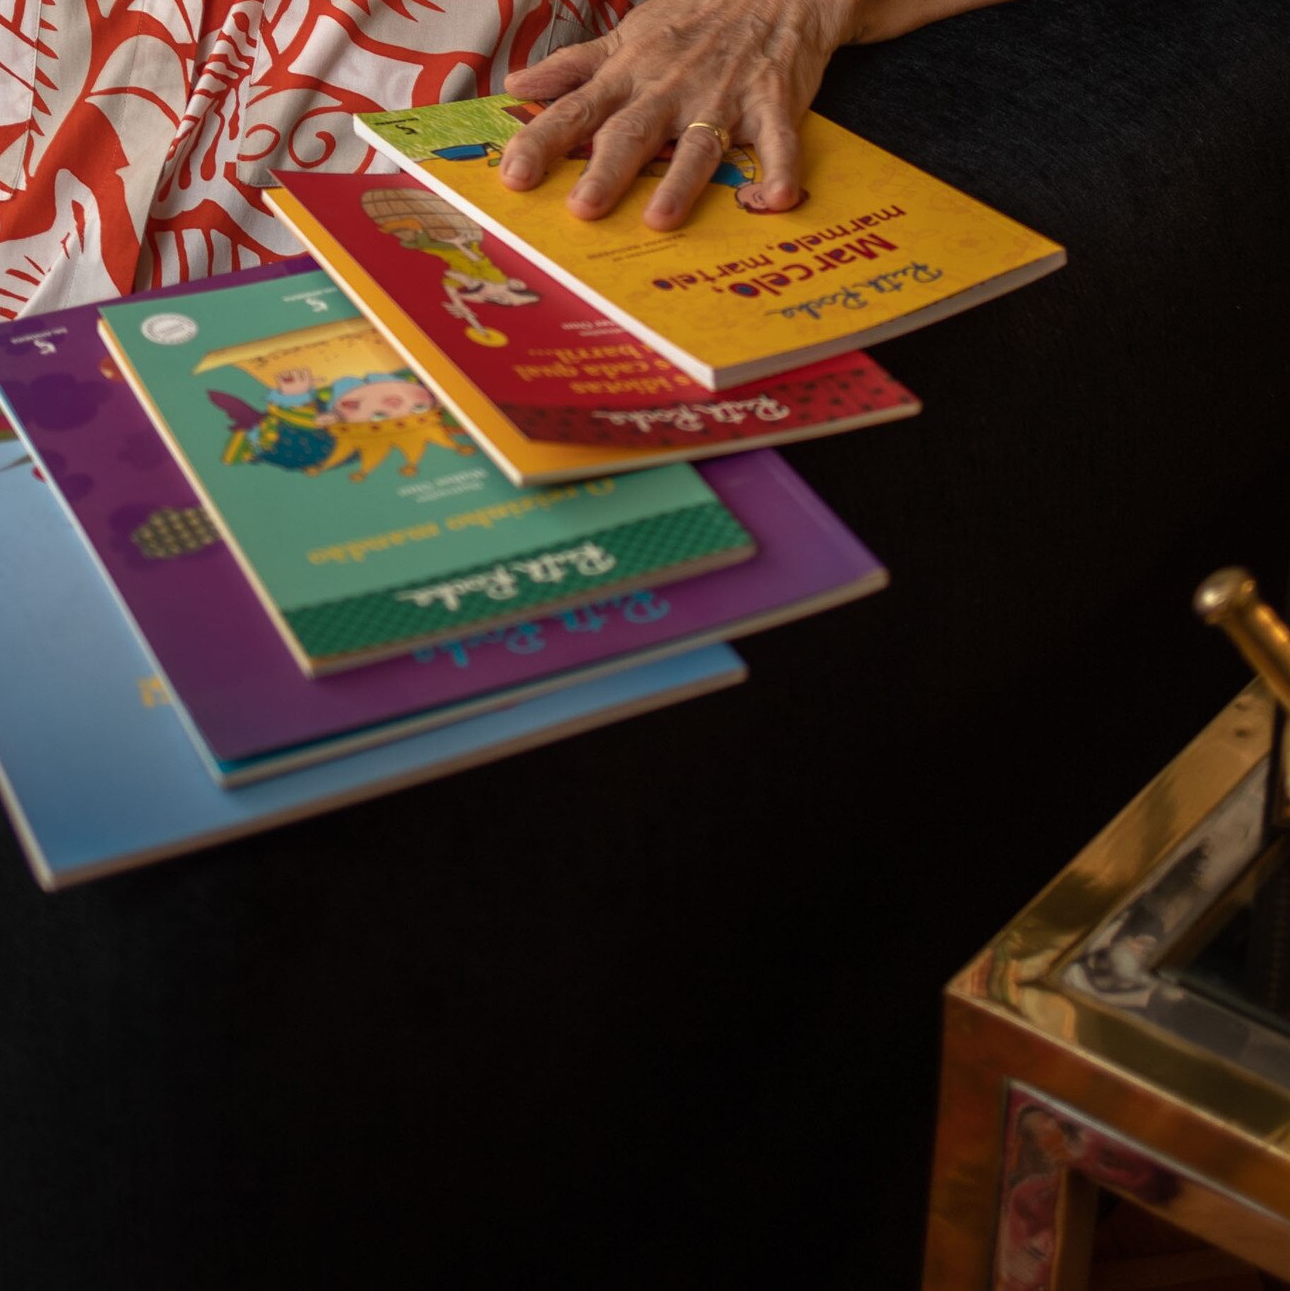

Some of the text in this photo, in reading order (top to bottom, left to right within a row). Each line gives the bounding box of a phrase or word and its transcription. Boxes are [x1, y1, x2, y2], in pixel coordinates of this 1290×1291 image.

[652, 205, 907, 292] marmelo, martelo
[713, 233, 899, 299] Marcelo,
[766, 261, 943, 320] Ruth Rocha
[591, 394, 790, 433] Ruth Rocha
[395, 541, 616, 611] Ruth Rocha
